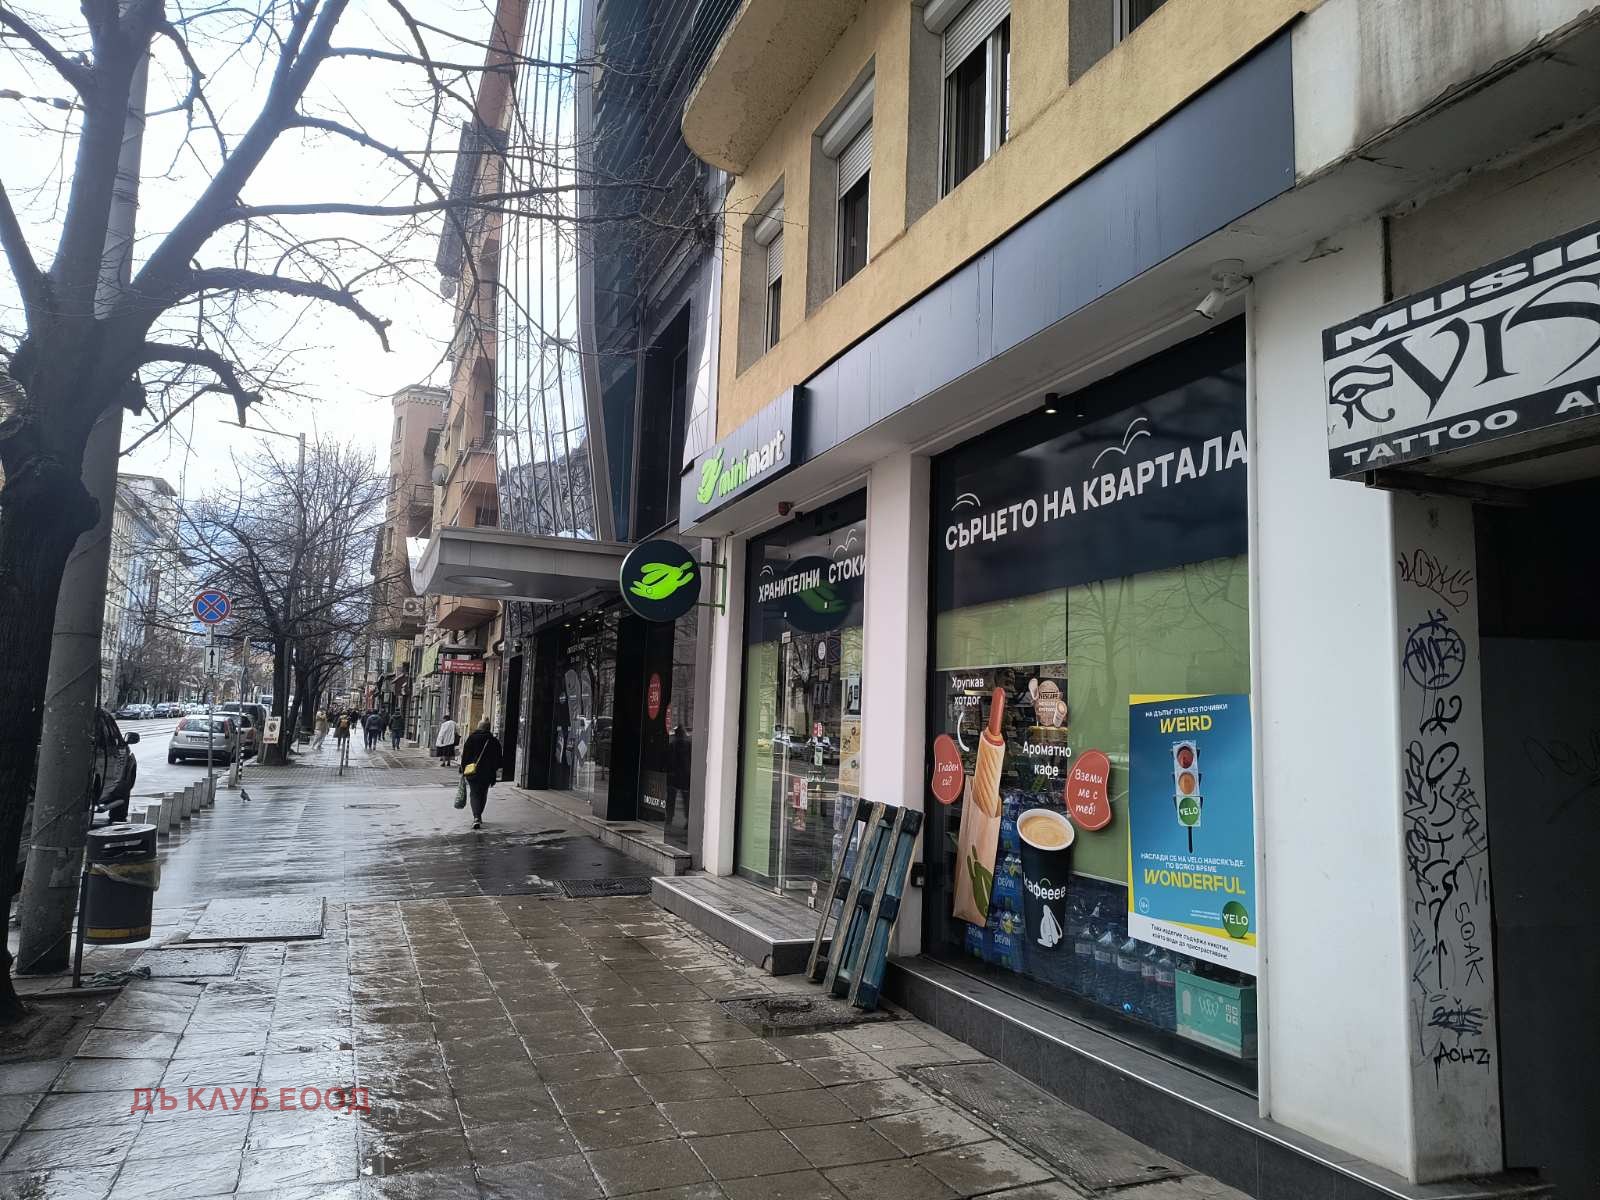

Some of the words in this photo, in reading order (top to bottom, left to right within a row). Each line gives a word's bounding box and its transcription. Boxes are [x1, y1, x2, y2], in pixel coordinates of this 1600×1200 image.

[1344, 409, 1518, 466] TATTOO
[1555, 386, 1600, 414] A
[719, 430, 785, 497] minimart
[945, 499, 1037, 551] СЪРЦЕТО
[1043, 486, 1083, 522] НА
[1083, 430, 1247, 510] КВАРТАЛА
[758, 568, 820, 603] ХРАНИТЕЛНИ
[828, 554, 867, 584] СТОКИ
[952, 676, 984, 690] Хрупкав
[954, 695, 981, 706] хотдог
[1187, 705, 1198, 714] БЕЗ
[1199, 703, 1228, 713] ПОЧИВКИ
[1160, 714, 1212, 733] WEIRD
[1023, 741, 1072, 758] Ароматно
[937, 762, 959, 772] Гладен
[1034, 764, 1059, 778] кафе
[942, 777, 952, 786] си?
[1075, 769, 1103, 784] Вземи
[1077, 787, 1090, 798] ме
[1093, 791, 1098, 800] с
[1075, 803, 1096, 816] теб!
[1180, 806, 1199, 816] VELO
[1141, 853, 1169, 862] НАСЛАДИ
[1177, 855, 1187, 863] НА
[1187, 856, 1203, 864] VELO
[1144, 868, 1246, 896] WONDERFUL
[1223, 912, 1249, 926] VELO
